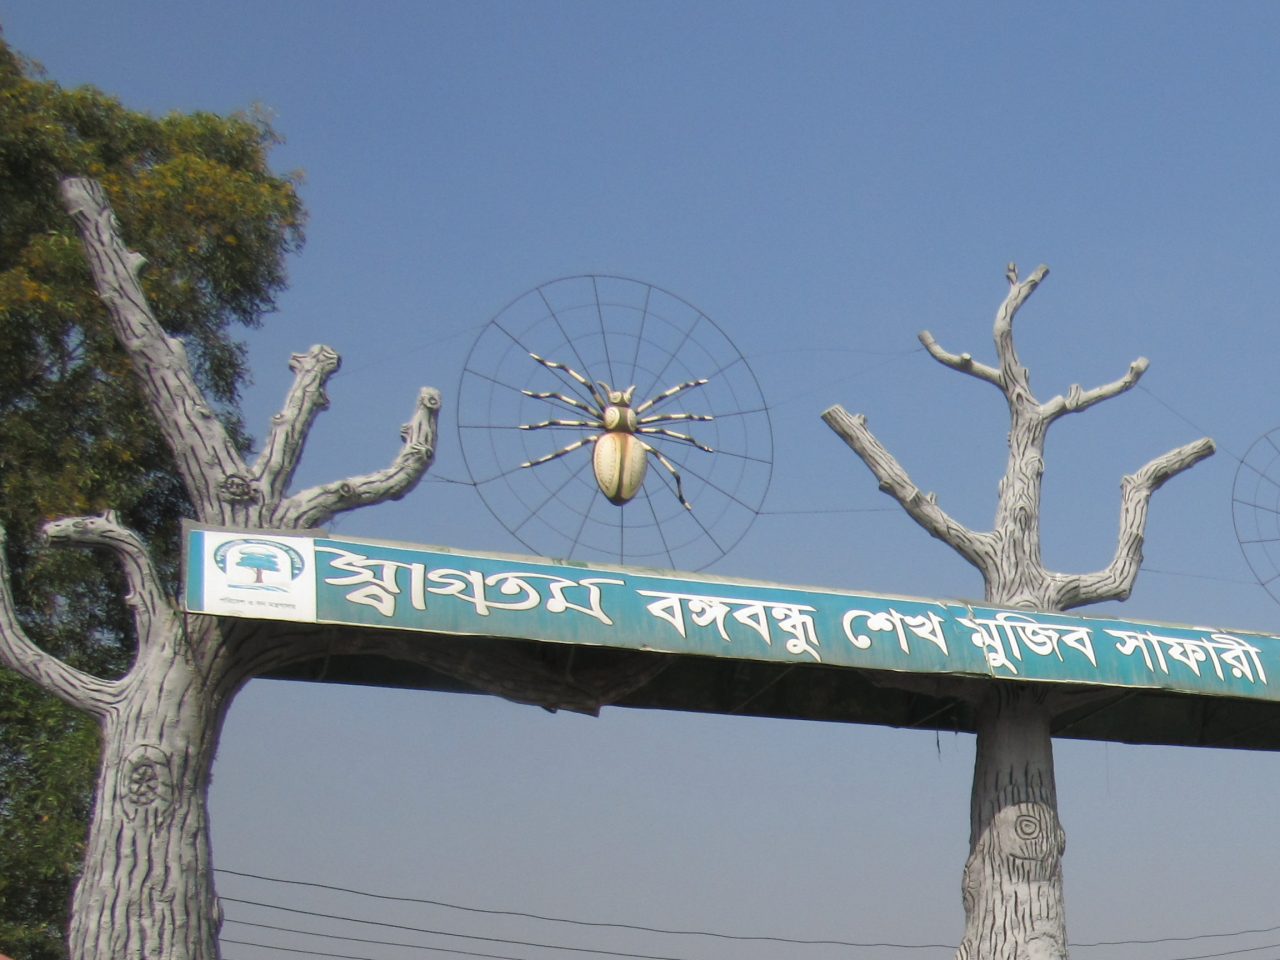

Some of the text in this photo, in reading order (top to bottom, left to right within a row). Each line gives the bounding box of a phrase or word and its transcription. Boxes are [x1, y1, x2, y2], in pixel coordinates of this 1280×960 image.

[636, 589, 822, 663] বঙ্গবন্ধু
[842, 608, 949, 657] শেখ
[955, 613, 1098, 675] মুজিব
[1103, 629, 1268, 685] সাফারী
